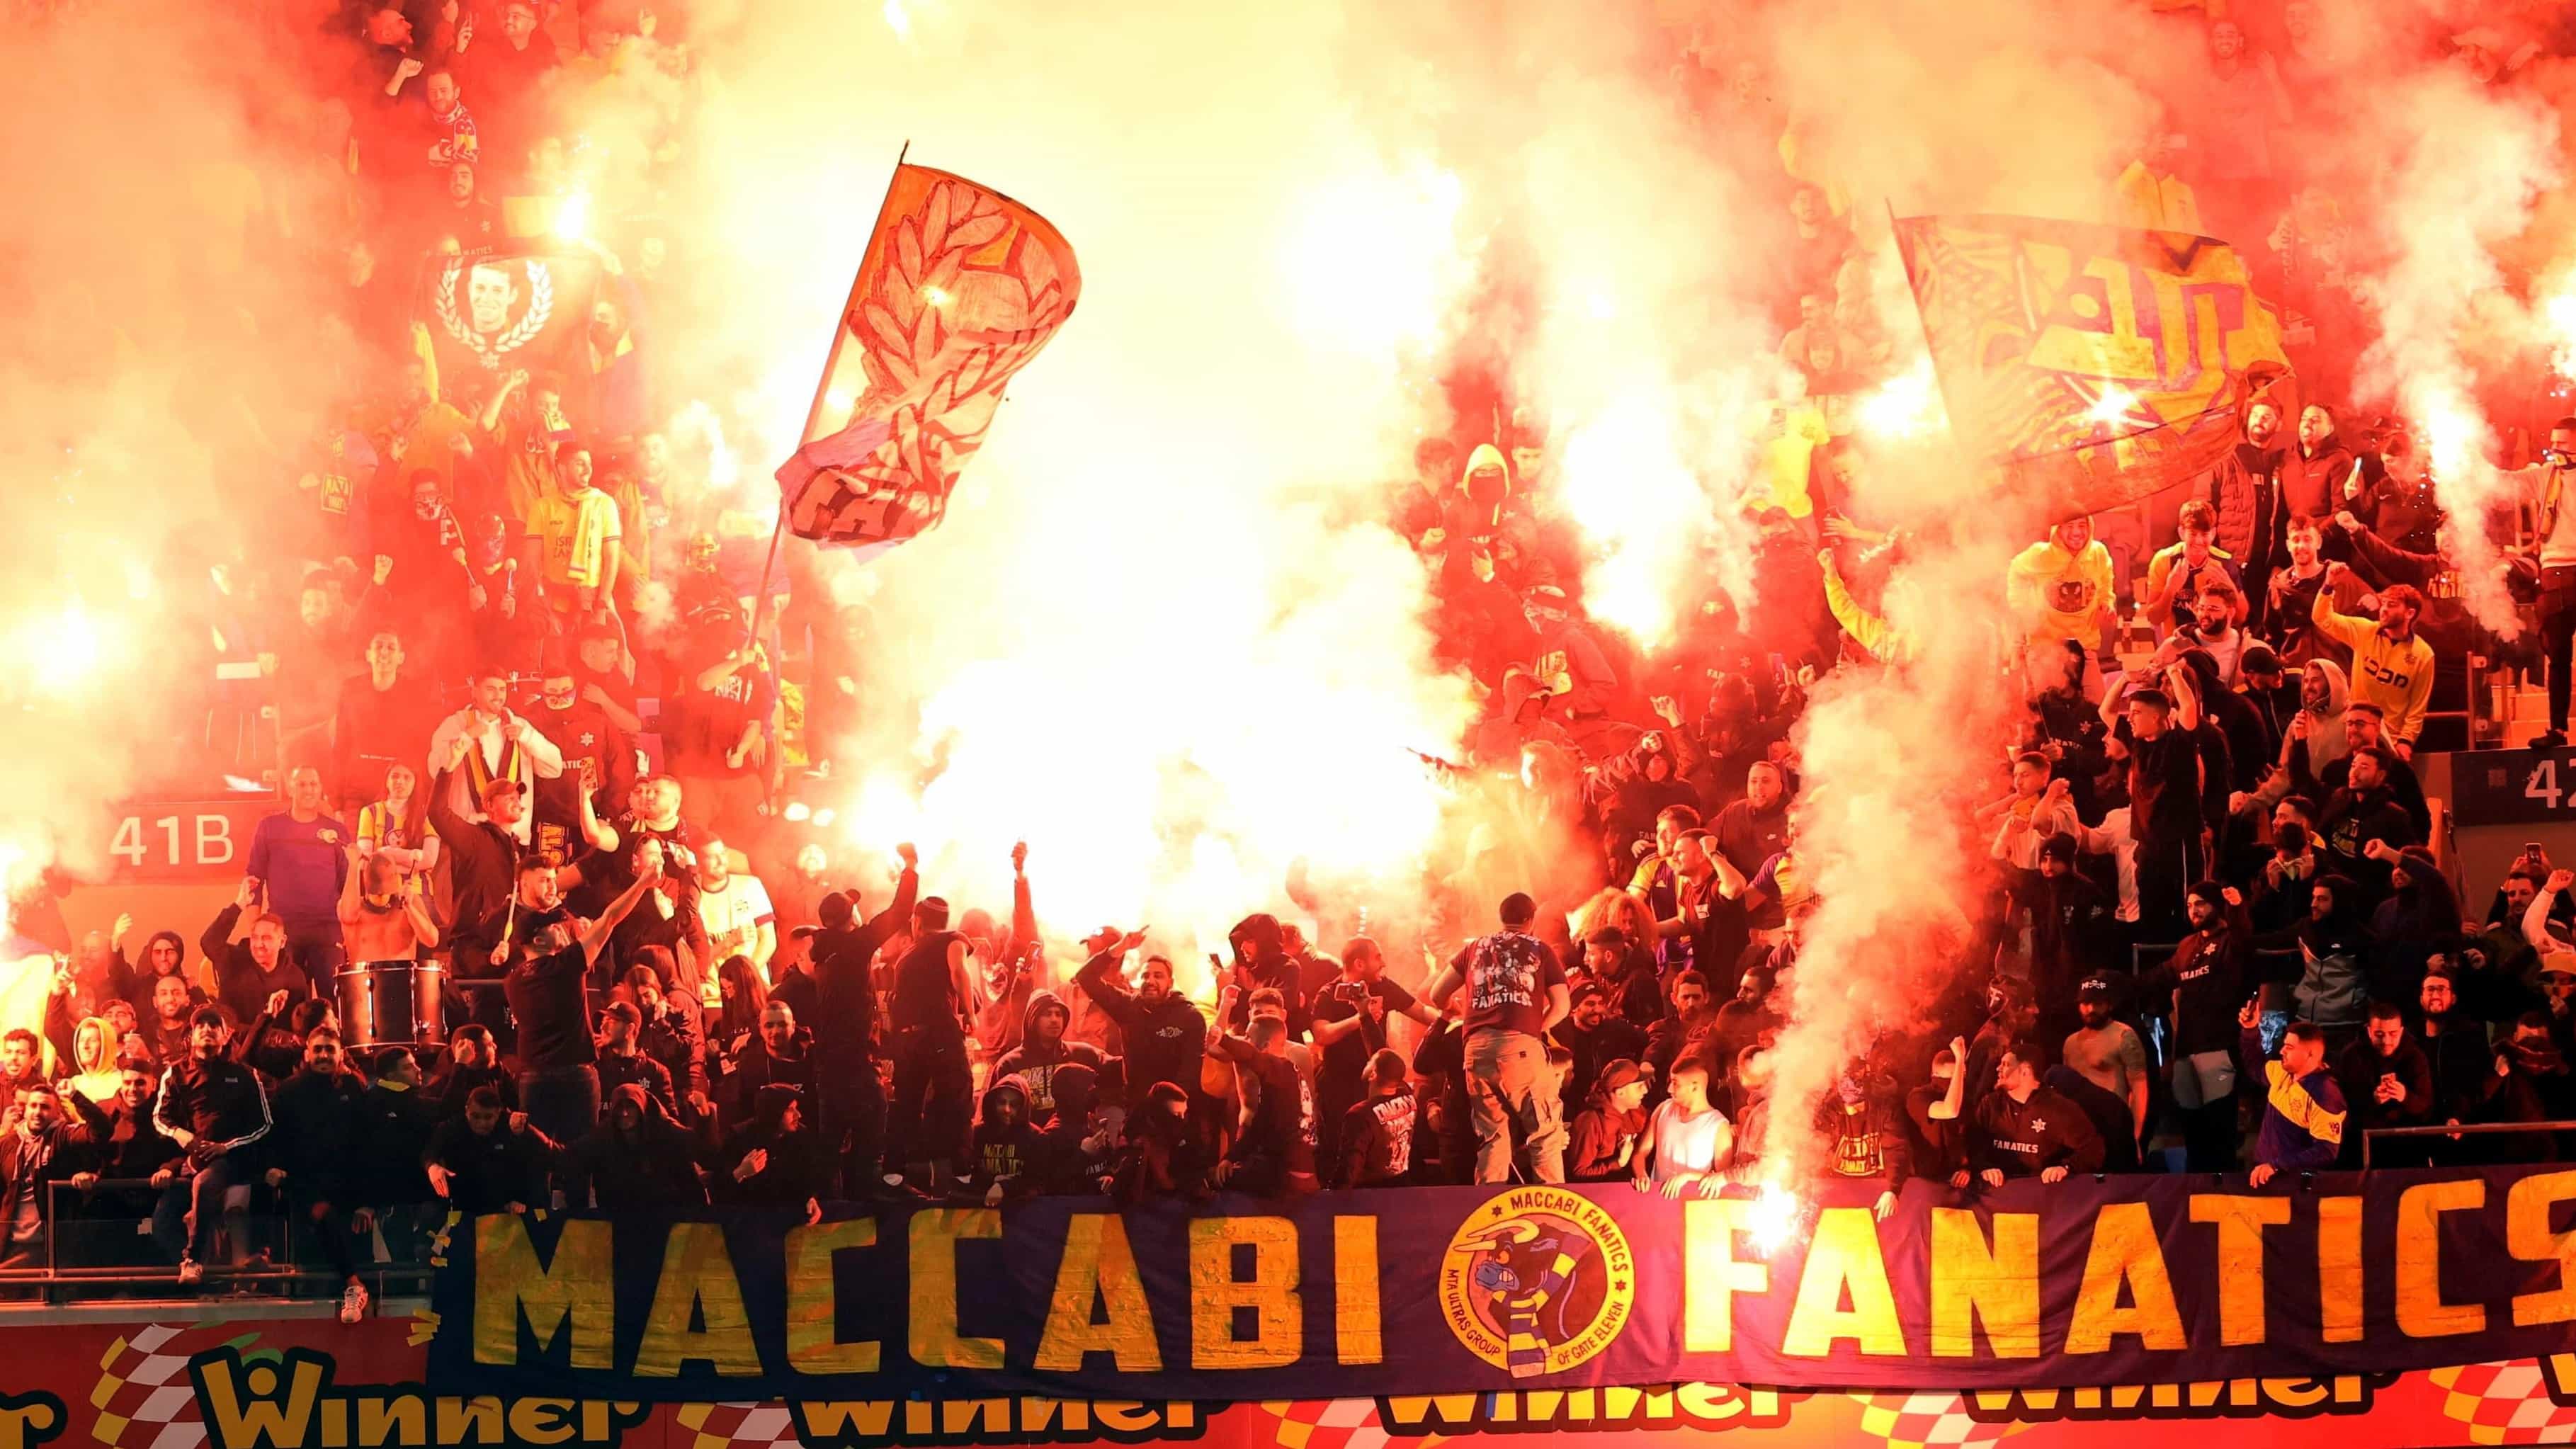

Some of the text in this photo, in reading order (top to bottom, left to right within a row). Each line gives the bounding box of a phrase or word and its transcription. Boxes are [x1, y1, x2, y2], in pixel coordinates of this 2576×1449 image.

[2525, 759, 2576, 808] 4
[109, 814, 234, 866] 41B
[1993, 1139, 2039, 1154] FANATICS
[1510, 1191, 1629, 1273] MACCABI FANATICS
[472, 1172, 2576, 1377] MACCABI FANATICS
[1446, 1268, 1501, 1357] MTA ULTRAS GROUP
[1572, 1337, 1599, 1359] GATE
[1594, 1301, 1624, 1341] ELEVEN
